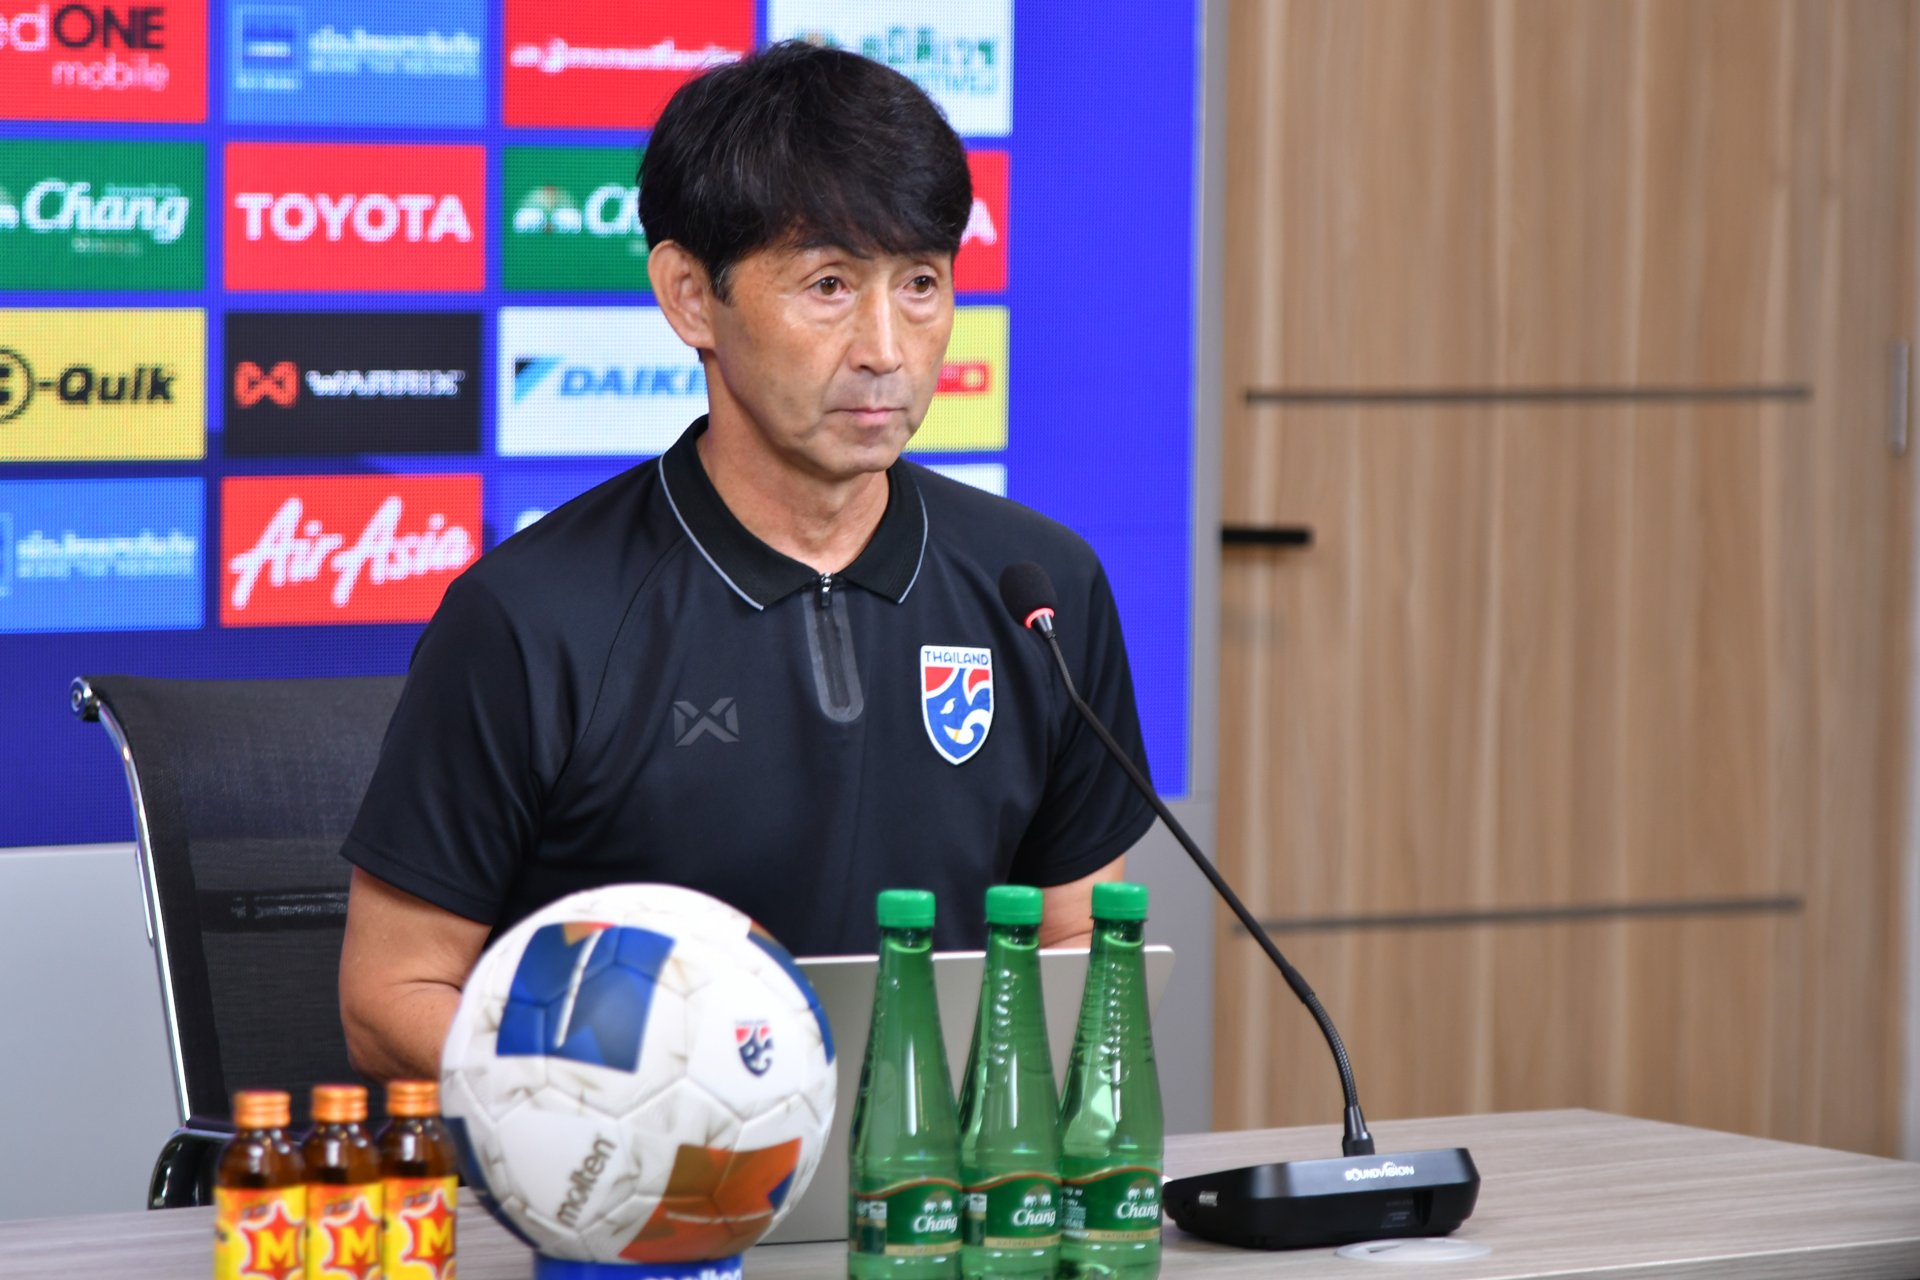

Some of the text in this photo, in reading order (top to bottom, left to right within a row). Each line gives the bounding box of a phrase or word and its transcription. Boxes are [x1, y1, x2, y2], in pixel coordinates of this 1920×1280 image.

[51, 52, 170, 91] mobile
[23, 179, 190, 243] Chang
[235, 193, 474, 243] TOYOTA
[924, 651, 989, 666] THAILAND
[556, 1132, 617, 1228] molten
[913, 1214, 958, 1234] Chang
[1012, 1208, 1057, 1227] Chang
[1116, 1201, 1159, 1220] Chang
